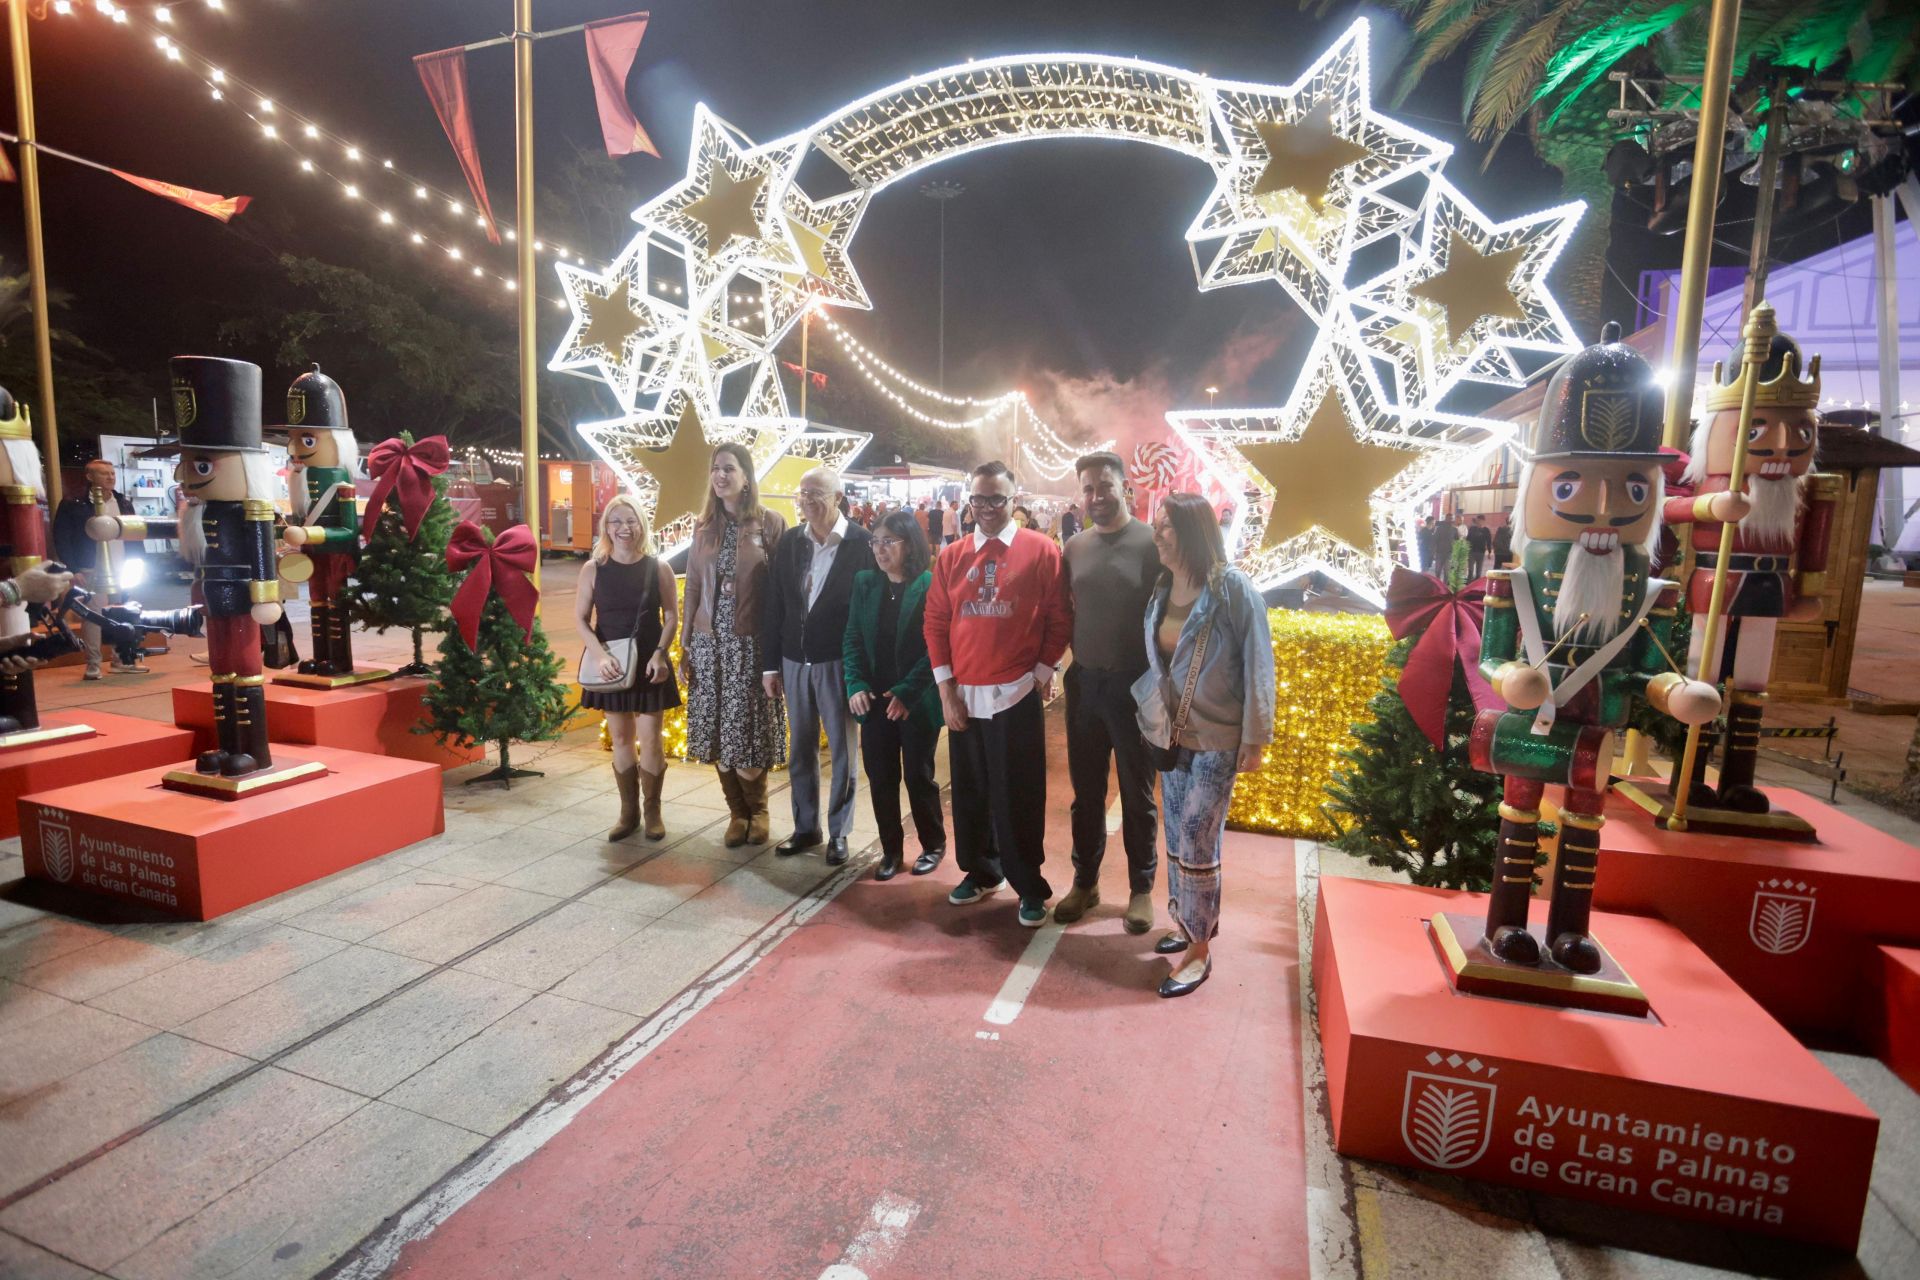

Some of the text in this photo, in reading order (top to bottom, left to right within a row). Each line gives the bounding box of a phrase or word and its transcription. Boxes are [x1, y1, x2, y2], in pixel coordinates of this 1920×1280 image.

[970, 601, 1007, 615] NAVIDAD
[80, 833, 175, 868] Ayuntamiento
[81, 852, 176, 887] de Las Palmas
[82, 870, 178, 905] de Gran Canaria
[1516, 1095, 1796, 1164] Ayuntamiento
[1513, 1124, 1791, 1195] de Las Palmas
[1509, 1152, 1784, 1225] de Gran Canaria
